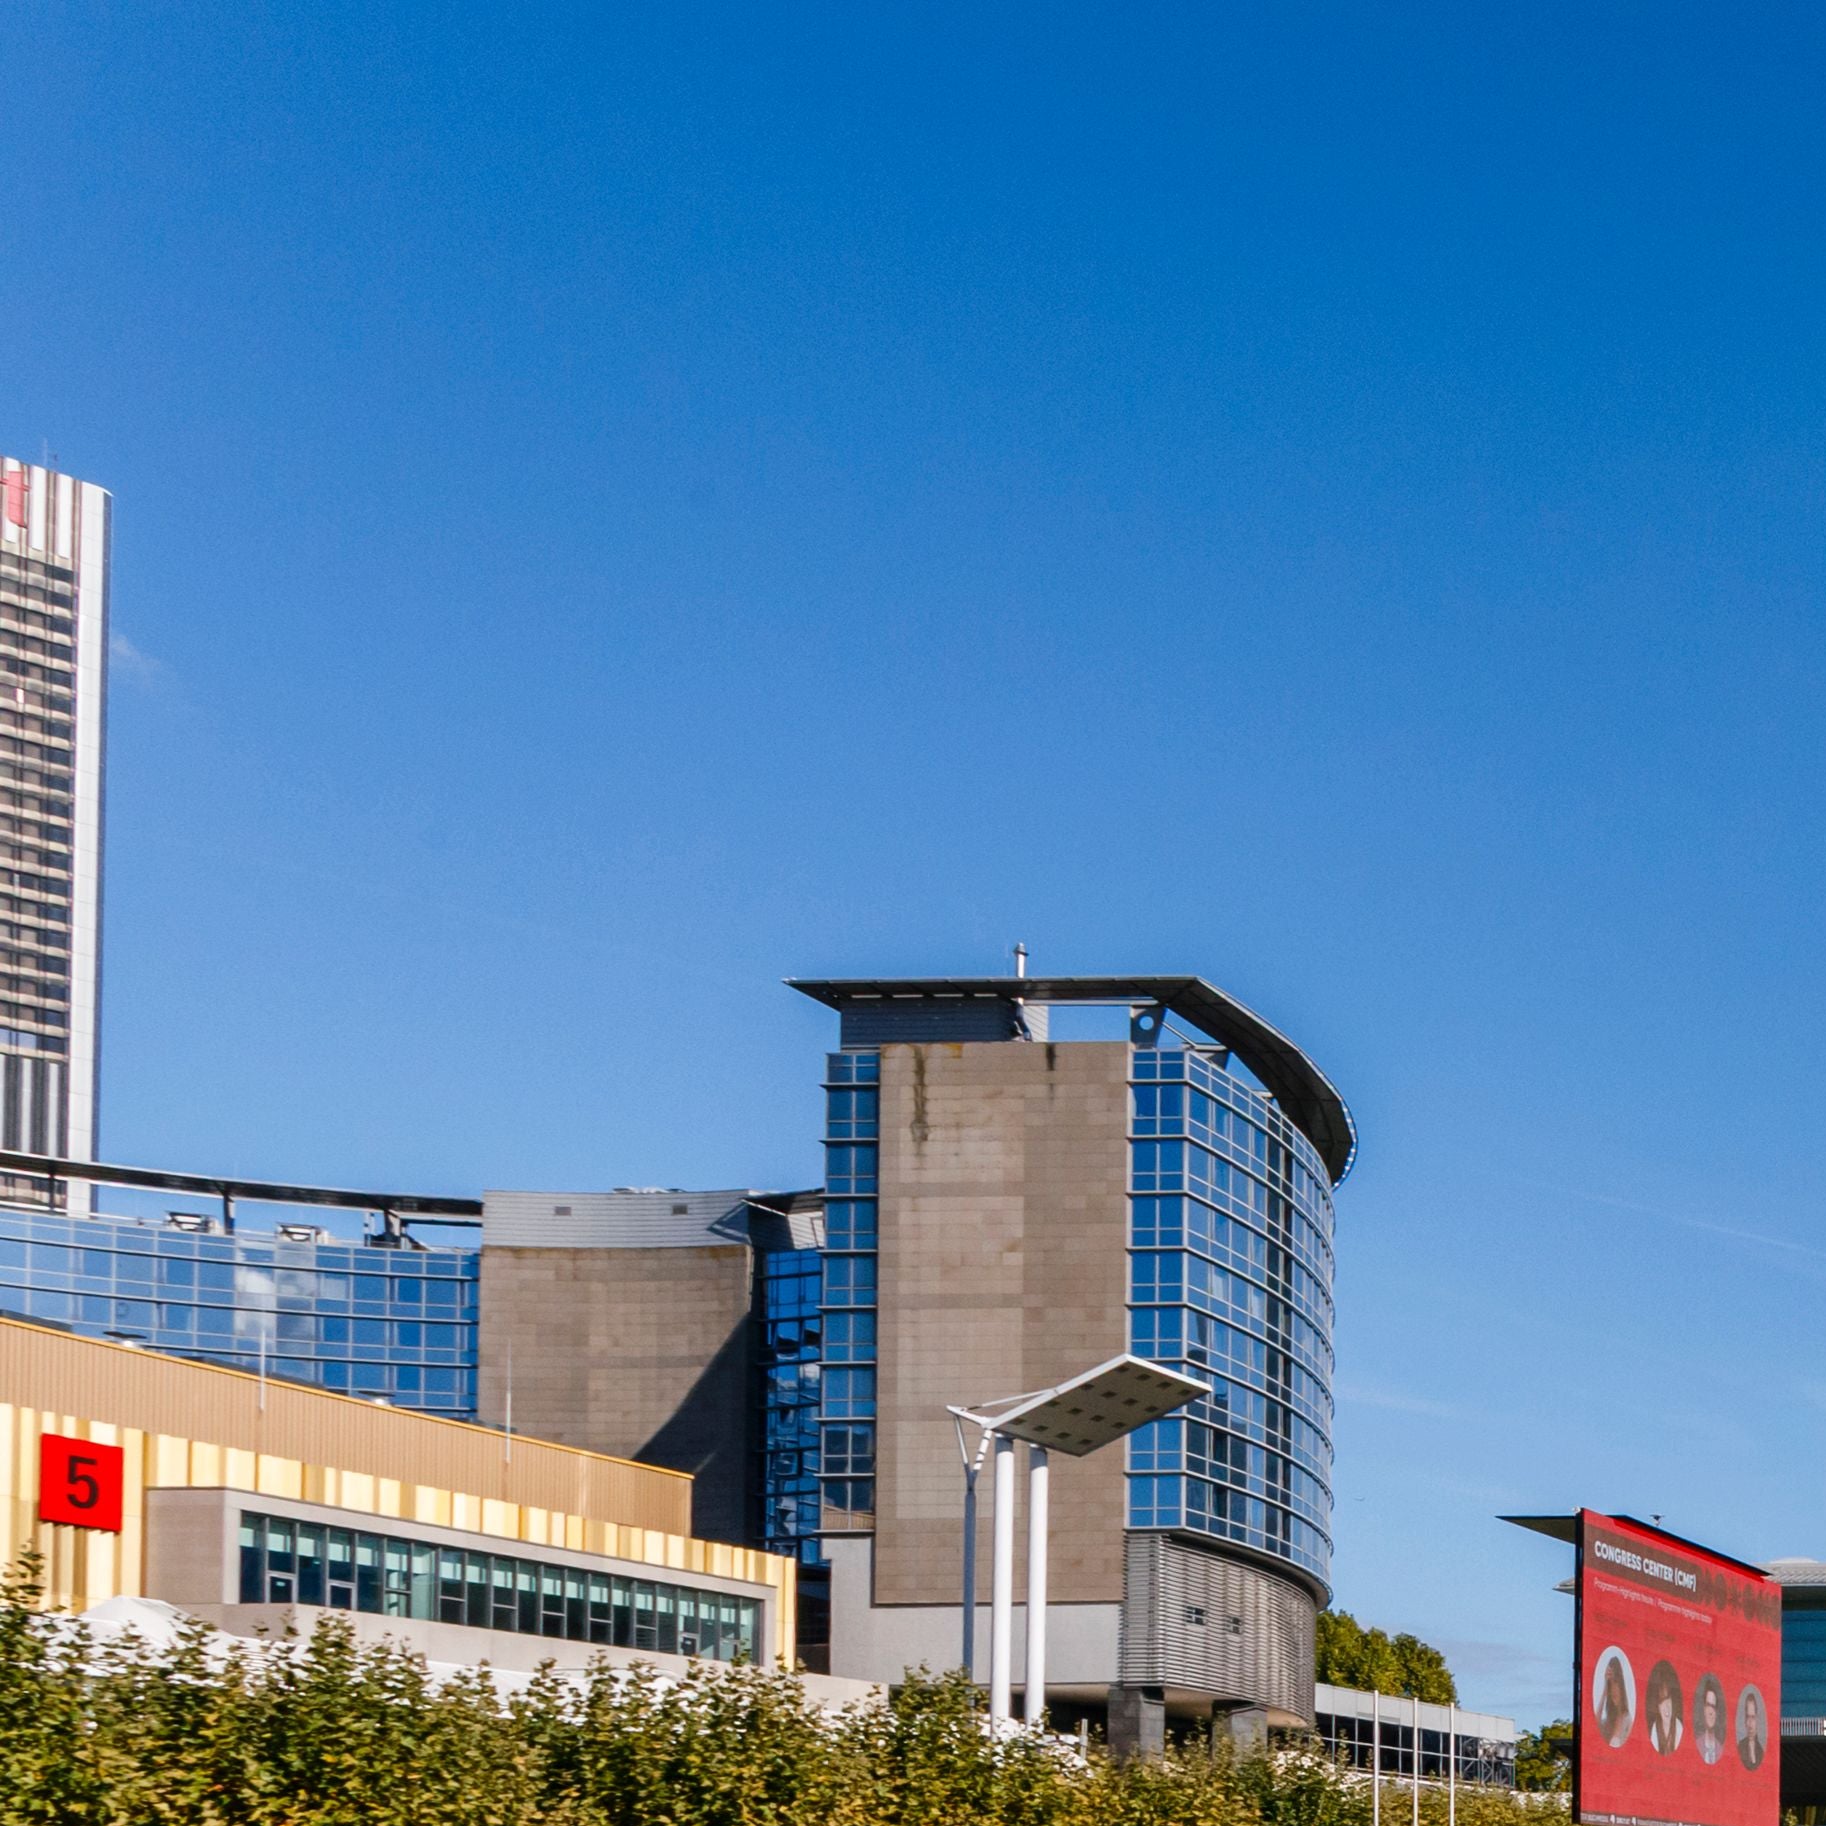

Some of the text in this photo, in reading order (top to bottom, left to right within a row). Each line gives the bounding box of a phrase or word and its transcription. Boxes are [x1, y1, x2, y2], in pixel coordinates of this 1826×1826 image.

[69, 1456, 98, 1509] 5
[1594, 1541, 1697, 1592] CONGRESS CENTER (CMF)
